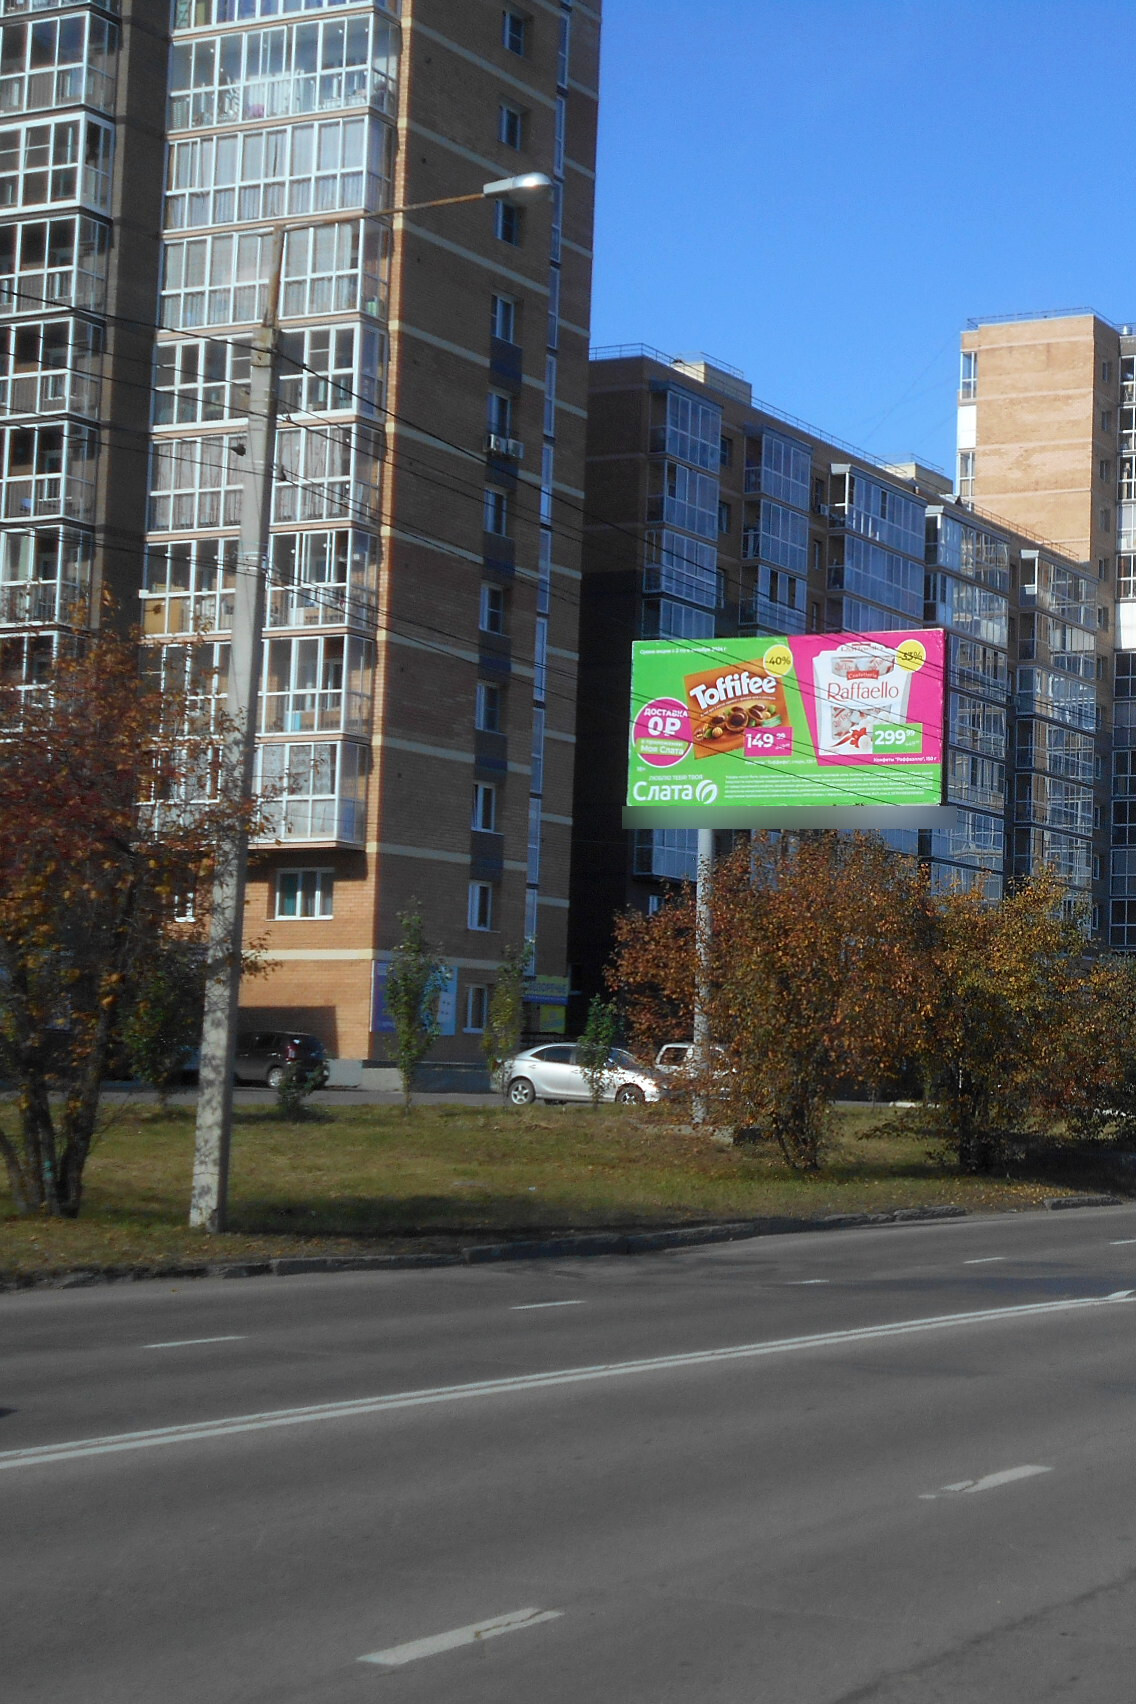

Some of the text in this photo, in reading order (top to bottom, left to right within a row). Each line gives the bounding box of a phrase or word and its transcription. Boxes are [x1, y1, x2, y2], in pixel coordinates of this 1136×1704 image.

[689, 671, 777, 710] Toffifee
[827, 682, 899, 701] Raffaello
[644, 708, 688, 718] ДОСТАВКА
[746, 733, 775, 748] 149
[874, 730, 906, 745] 299
[633, 781, 693, 801] Слата
